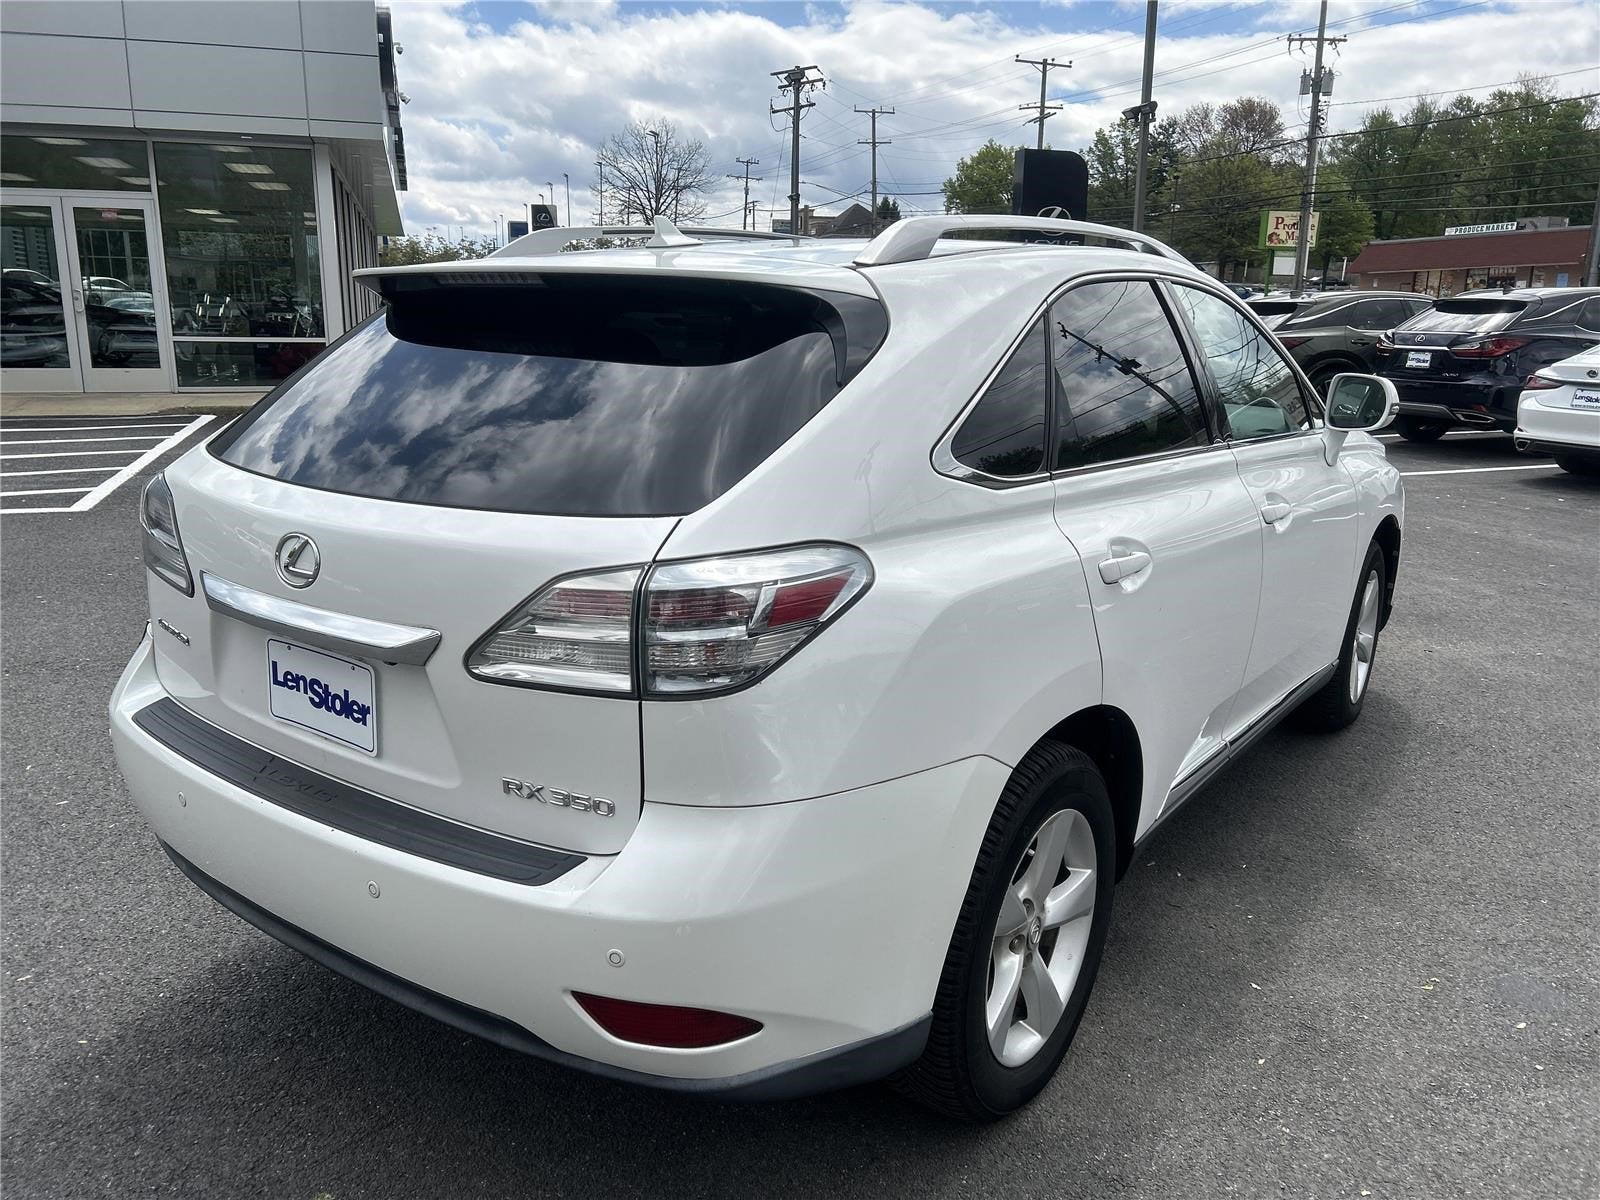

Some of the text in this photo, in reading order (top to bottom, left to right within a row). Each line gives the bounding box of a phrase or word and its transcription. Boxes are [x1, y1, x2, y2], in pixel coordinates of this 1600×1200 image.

[1274, 216, 1316, 231] Prode
[1454, 225, 1484, 234] PRODUCE
[1485, 222, 1516, 231] MARKET
